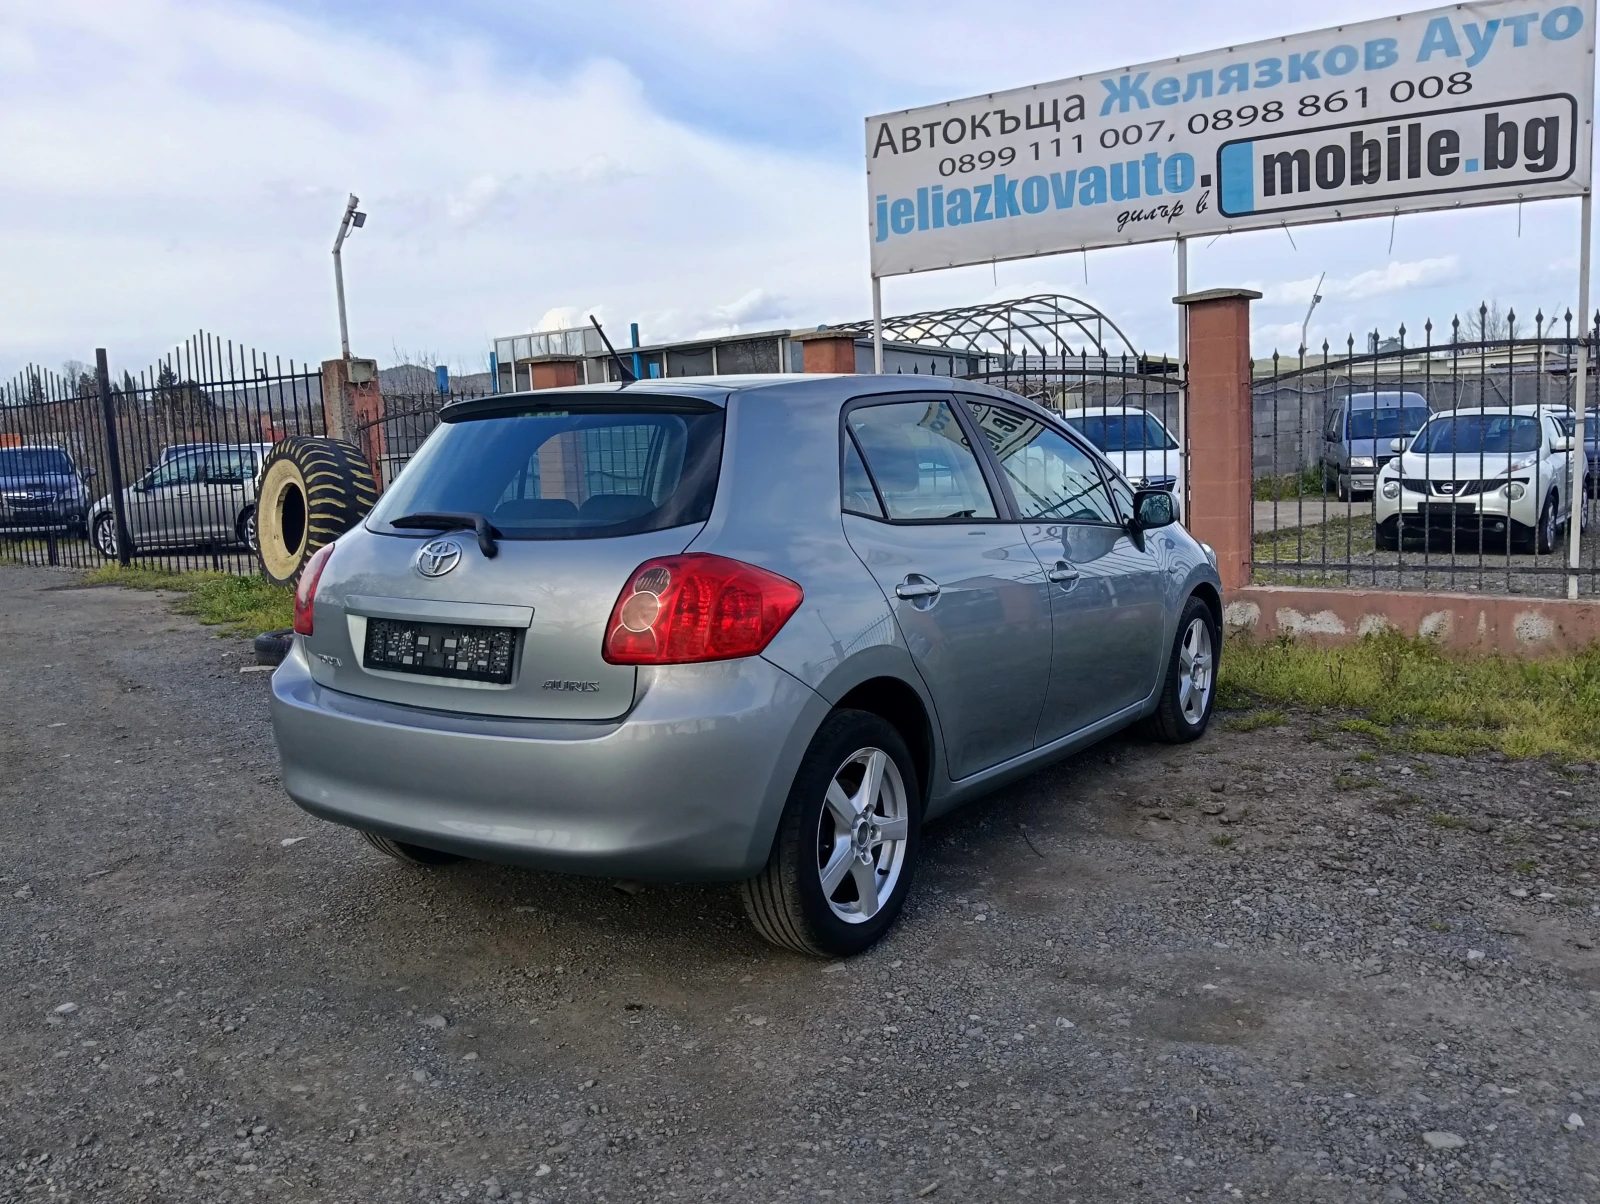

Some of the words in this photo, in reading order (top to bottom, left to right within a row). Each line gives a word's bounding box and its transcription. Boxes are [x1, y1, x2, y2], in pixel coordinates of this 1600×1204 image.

[872, 94, 1086, 159] Автокъща
[1099, 37, 1399, 117] Желязков
[1416, 5, 1584, 68] Ауто
[938, 146, 1017, 177] 0899
[1029, 134, 1083, 161] 111
[1100, 120, 1175, 149] 007,
[1187, 100, 1284, 135] 0898
[1298, 87, 1369, 117] 861
[1389, 71, 1473, 103] 008
[1263, 112, 1560, 197] mobile.bg
[1116, 200, 1184, 233] дилър
[541, 679, 600, 692] AURIS
